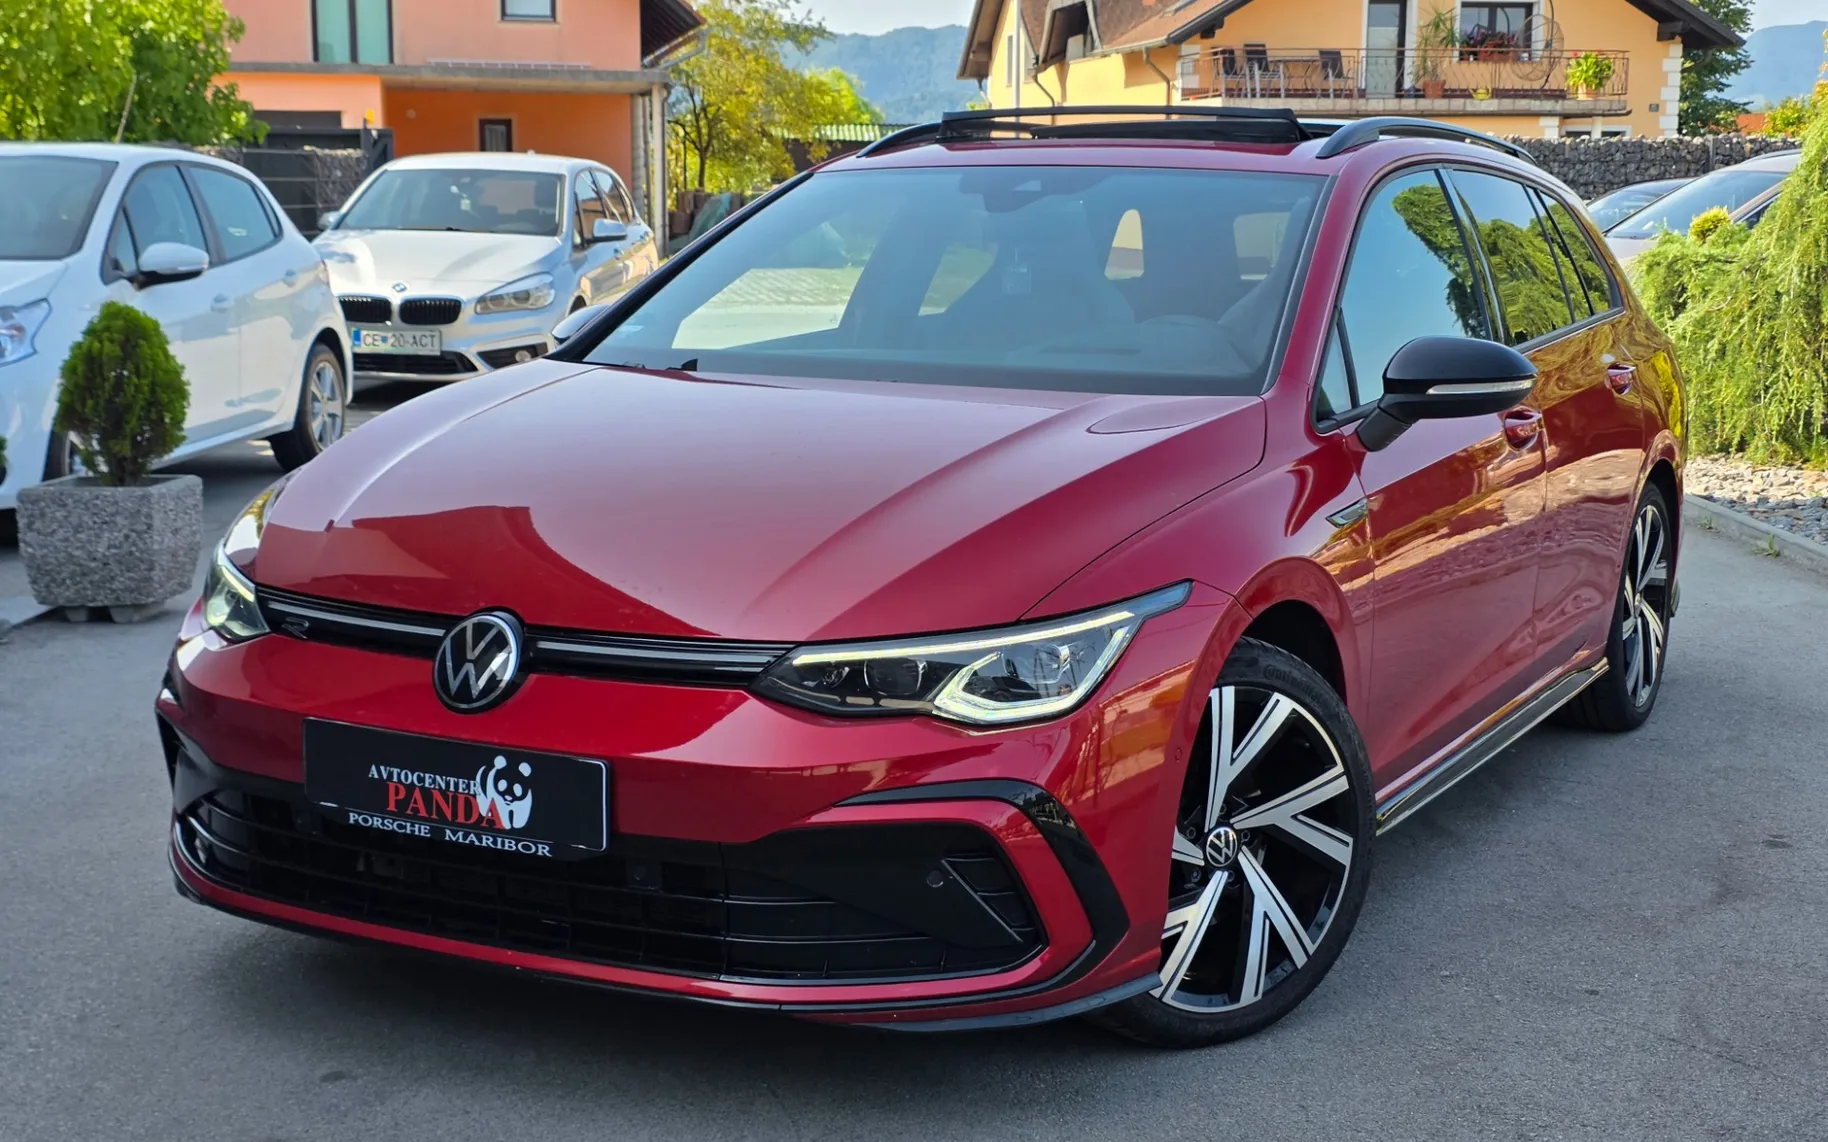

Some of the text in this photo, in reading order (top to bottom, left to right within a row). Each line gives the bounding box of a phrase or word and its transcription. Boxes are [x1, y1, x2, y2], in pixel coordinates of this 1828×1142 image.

[363, 333, 436, 348] CE 20-ACT
[368, 763, 481, 796] AVTOCENTER
[386, 781, 504, 829] PANDA
[348, 812, 552, 857] PORSCHE MARIBOR
